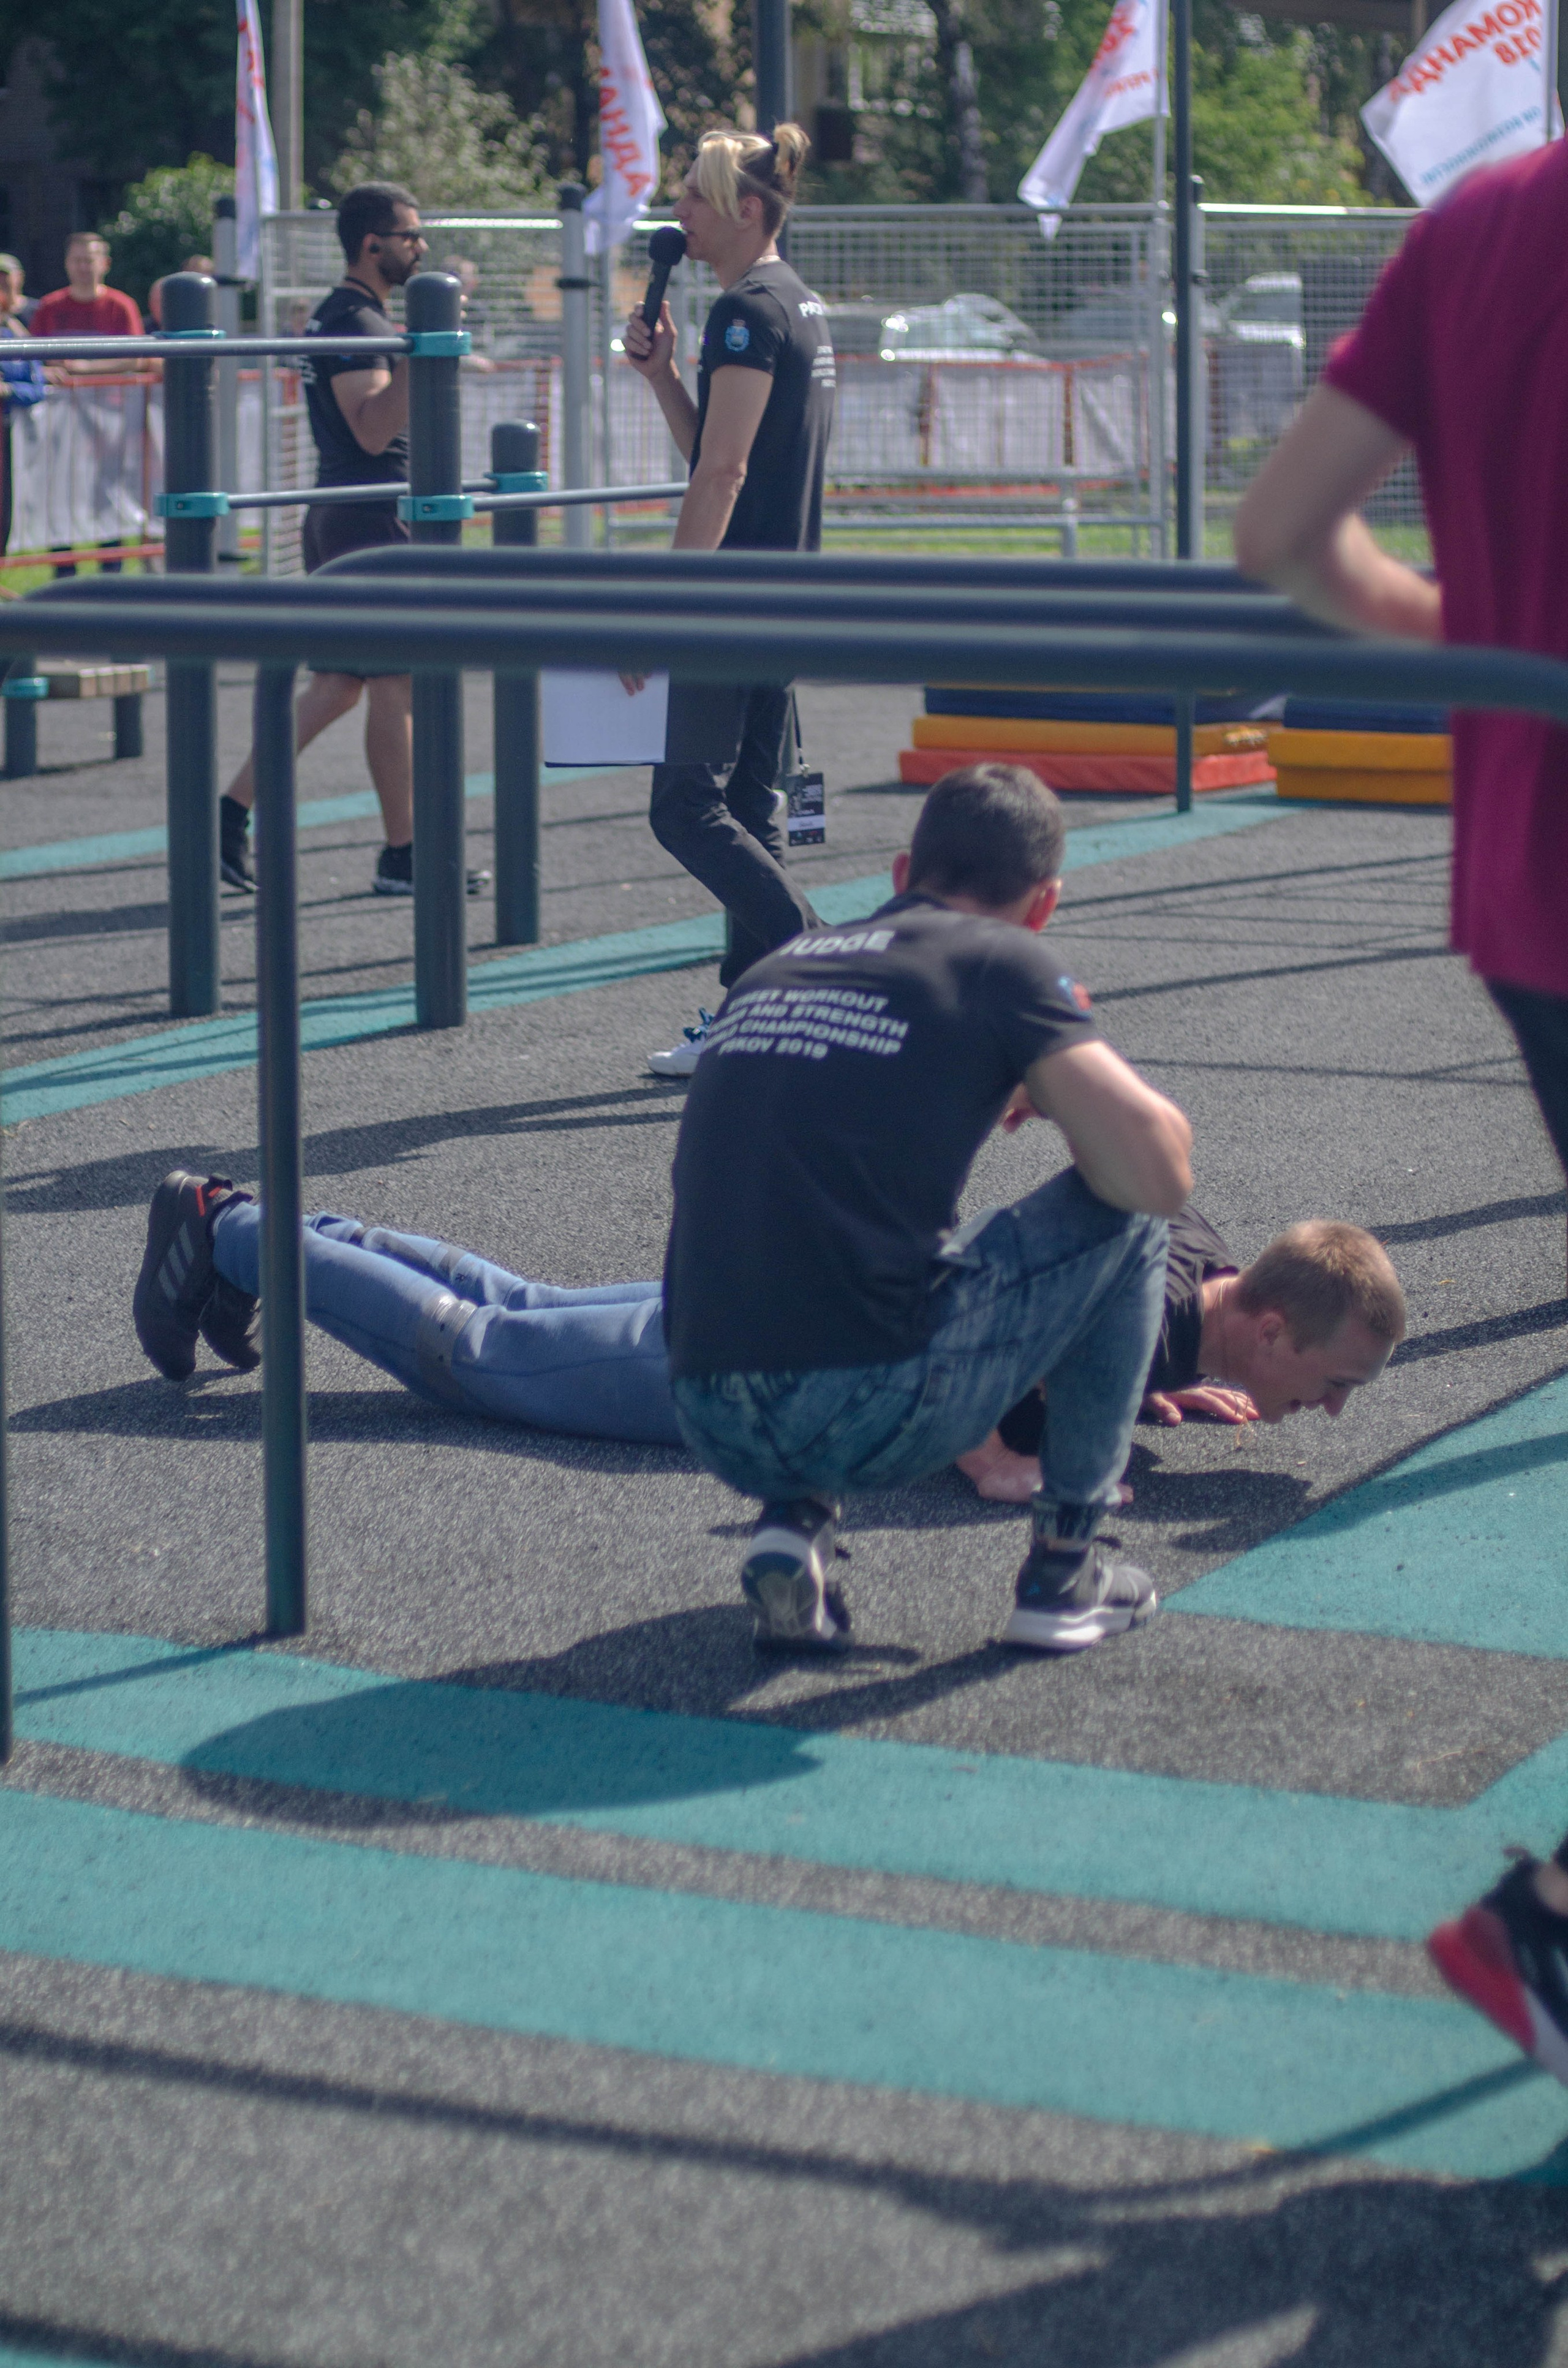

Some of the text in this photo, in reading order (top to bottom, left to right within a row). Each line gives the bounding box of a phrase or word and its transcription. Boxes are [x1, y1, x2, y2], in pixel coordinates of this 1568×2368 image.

[779, 929, 895, 956] JUDGE
[783, 989, 889, 1013] WORKOUT
[748, 1003, 908, 1038] AND STRENGTH
[739, 1019, 902, 1056] CHAMPIONSHIP
